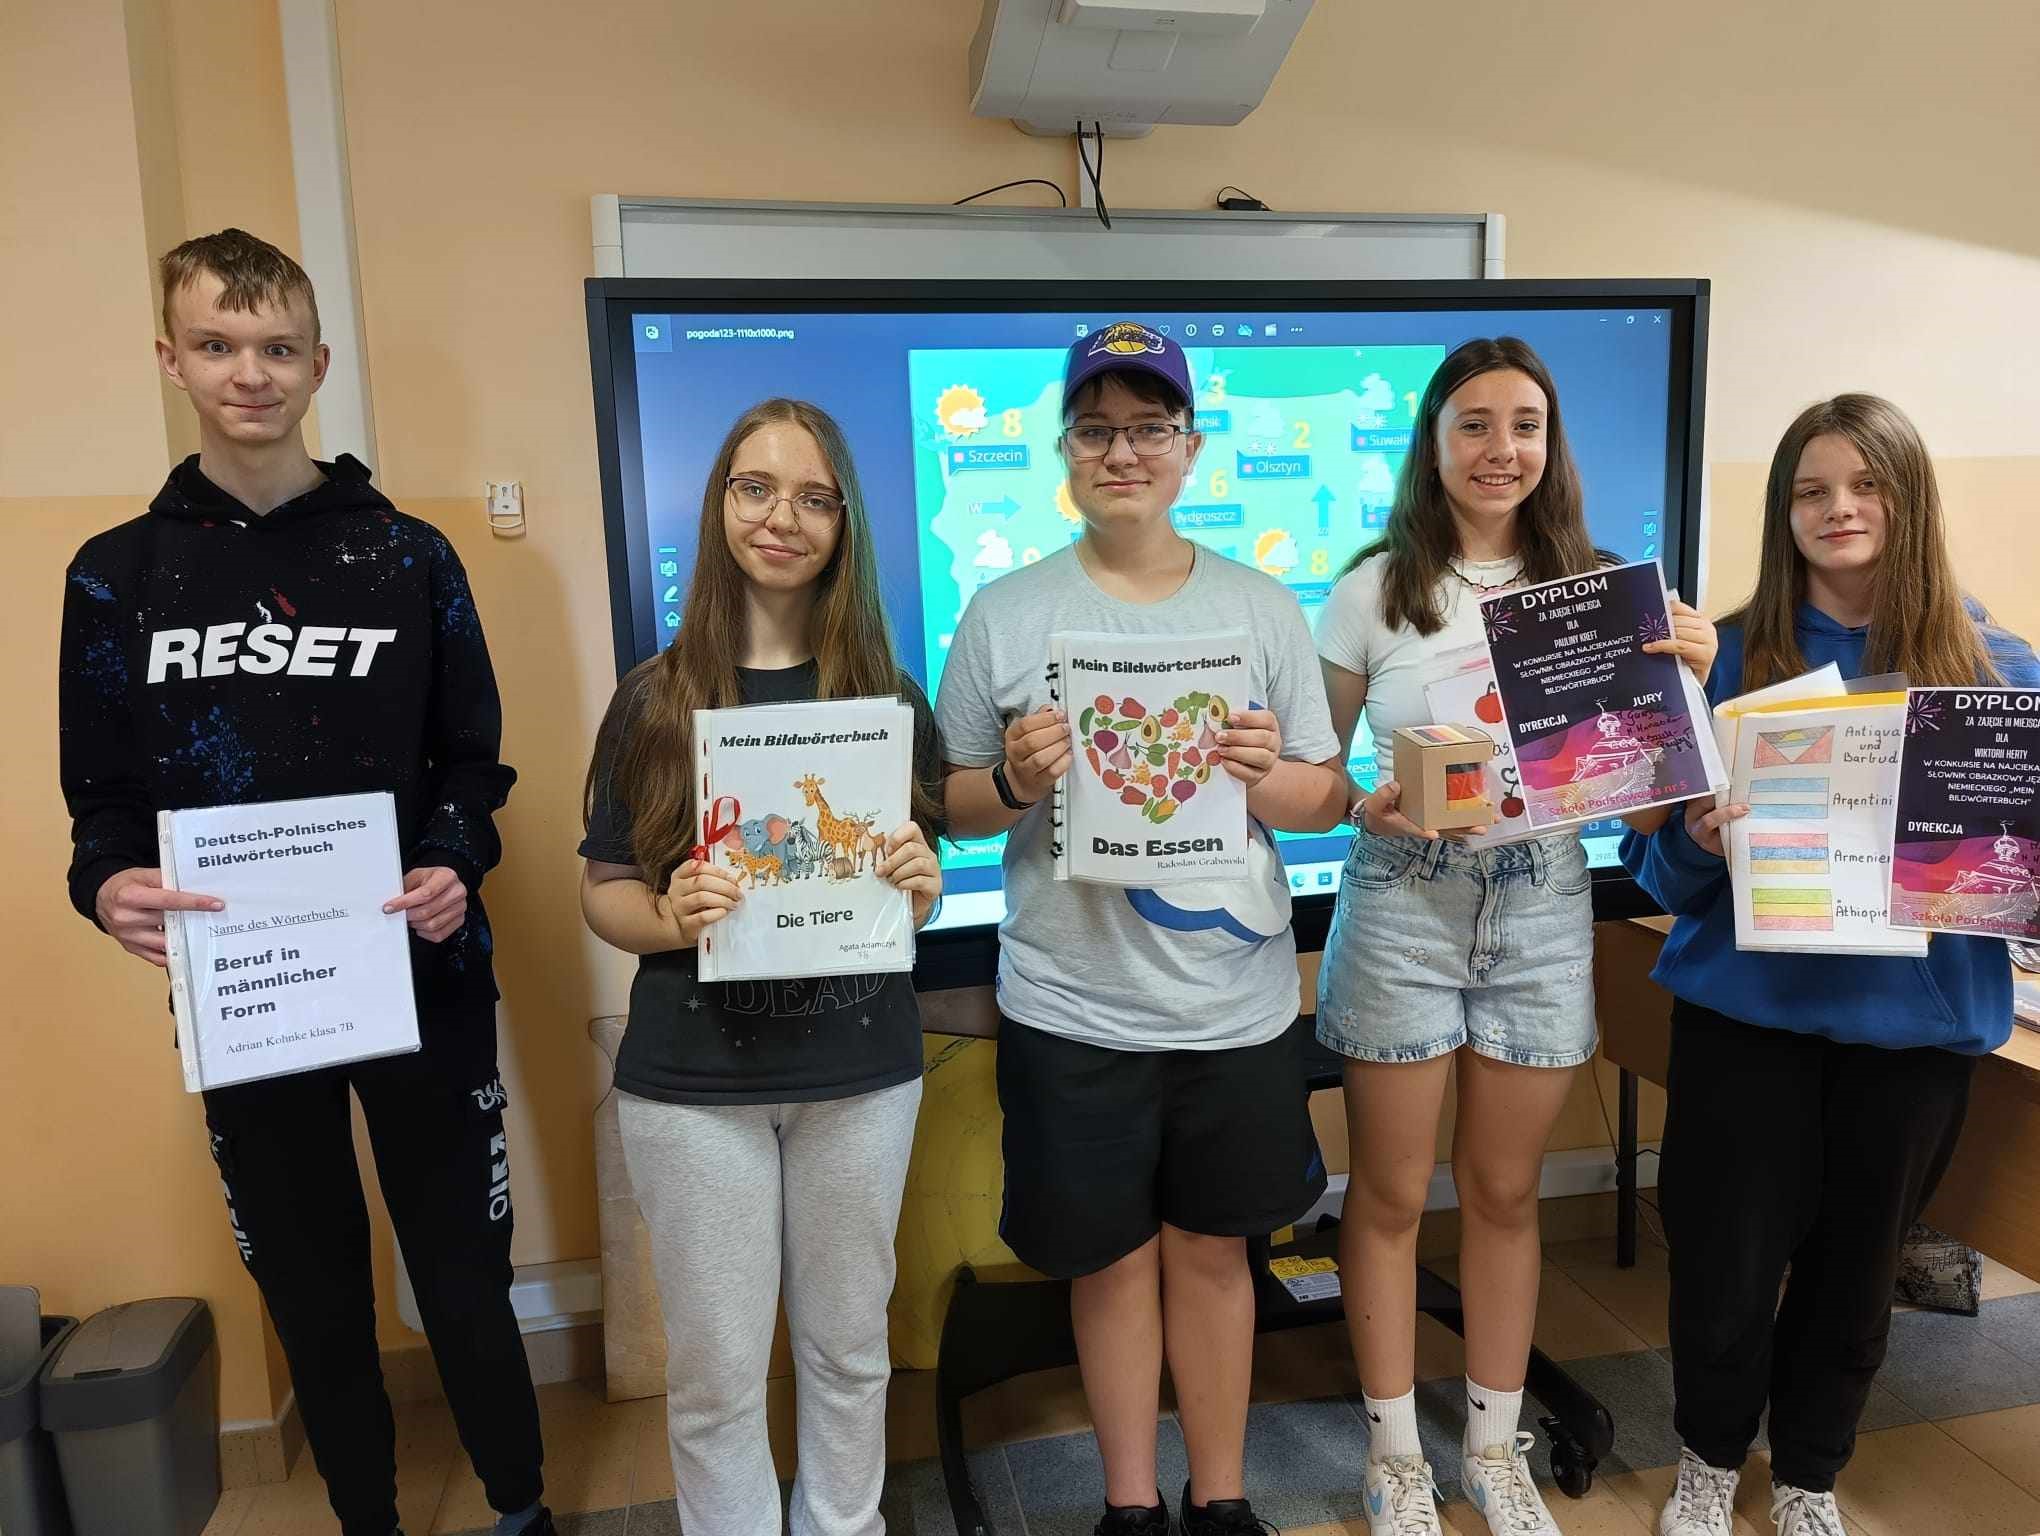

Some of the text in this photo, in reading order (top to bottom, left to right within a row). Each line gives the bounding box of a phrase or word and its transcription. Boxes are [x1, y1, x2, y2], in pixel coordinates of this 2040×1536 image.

[1207, 374, 1226, 404] 3
[1002, 408, 1024, 438] 8
[1293, 420, 1313, 449] 2
[968, 449, 1024, 464] Szczecin
[1255, 459, 1302, 477] Olsztyn
[1210, 467, 1229, 498] 6
[1310, 548, 1330, 577] 8
[1520, 575, 1609, 610] DYPLOM
[1538, 611, 1548, 622] ZA
[1566, 619, 1580, 631] DLA
[146, 622, 398, 685] RESET
[1512, 661, 1522, 670] W
[1522, 650, 1564, 668] KONKURSIE
[1564, 648, 1577, 658] NA
[1071, 654, 1243, 675] Mein Bildwörterbuch
[1539, 667, 1592, 685] NIEMIECKIEGO
[1632, 690, 1664, 708] JURY
[1519, 714, 1569, 736] DYREKCJA
[1964, 715, 1975, 727] ZA
[718, 728, 889, 748] Mein Bildwörterbuch
[1859, 738, 1883, 752] und
[1995, 732, 2010, 744] DLA
[1843, 751, 1898, 764] Barbud
[1923, 759, 2040, 773] W KONKURSIE NA NAJCIEKA
[1947, 783, 2008, 795] NIEMIECKIEGO
[1550, 803, 1586, 817] Szkoła
[1832, 792, 1894, 811] Argentini
[194, 819, 367, 849] Deutsch-Polnisches
[1907, 821, 1964, 835] DYREKCJA
[197, 841, 334, 868] Bildwörterbuch
[1092, 837, 1224, 857] Das Essen
[776, 908, 854, 929] Die Tiere
[1835, 899, 1888, 923] Äthiopie
[1911, 911, 1952, 922] Szkoła
[209, 923, 245, 937] Name
[247, 919, 269, 931] des
[839, 943, 860, 952] Agata
[214, 947, 301, 973] Beruf in
[217, 966, 338, 997] männlicher
[220, 1000, 277, 1021] Form
[225, 1041, 264, 1055] Adrian
[309, 1026, 337, 1038] klasa
[339, 1021, 355, 1032] 7B
